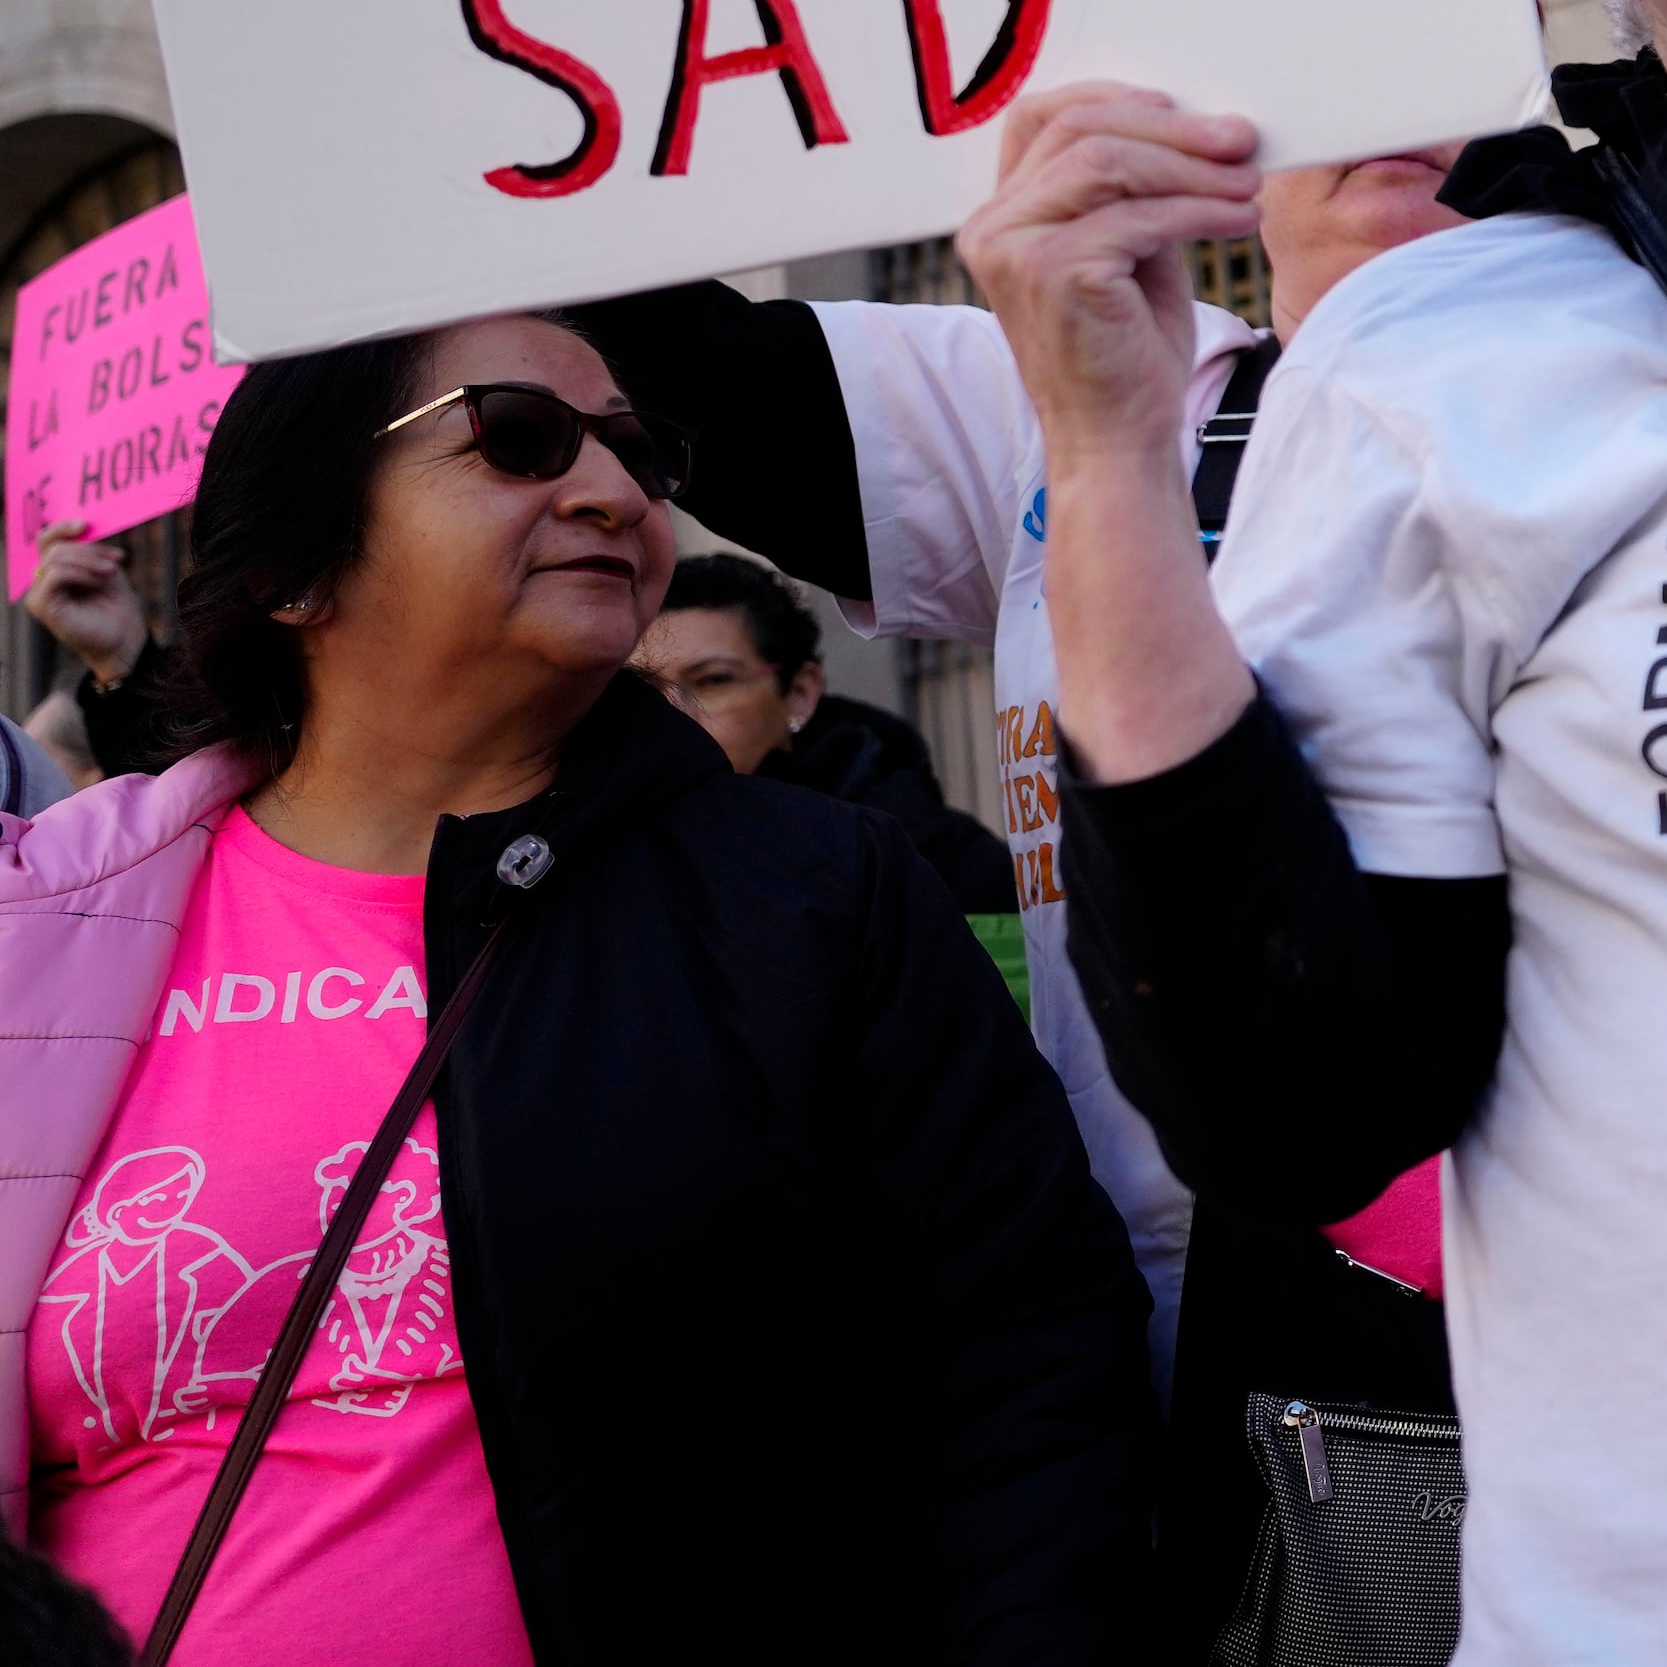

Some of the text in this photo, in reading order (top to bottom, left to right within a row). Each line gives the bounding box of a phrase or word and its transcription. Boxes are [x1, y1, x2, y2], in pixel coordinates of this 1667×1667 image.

[40, 243, 180, 362] FUERA
[27, 318, 206, 452] LA BOLS
[145, 964, 429, 1043] NDICA
[1411, 1491, 1468, 1527] Vog
